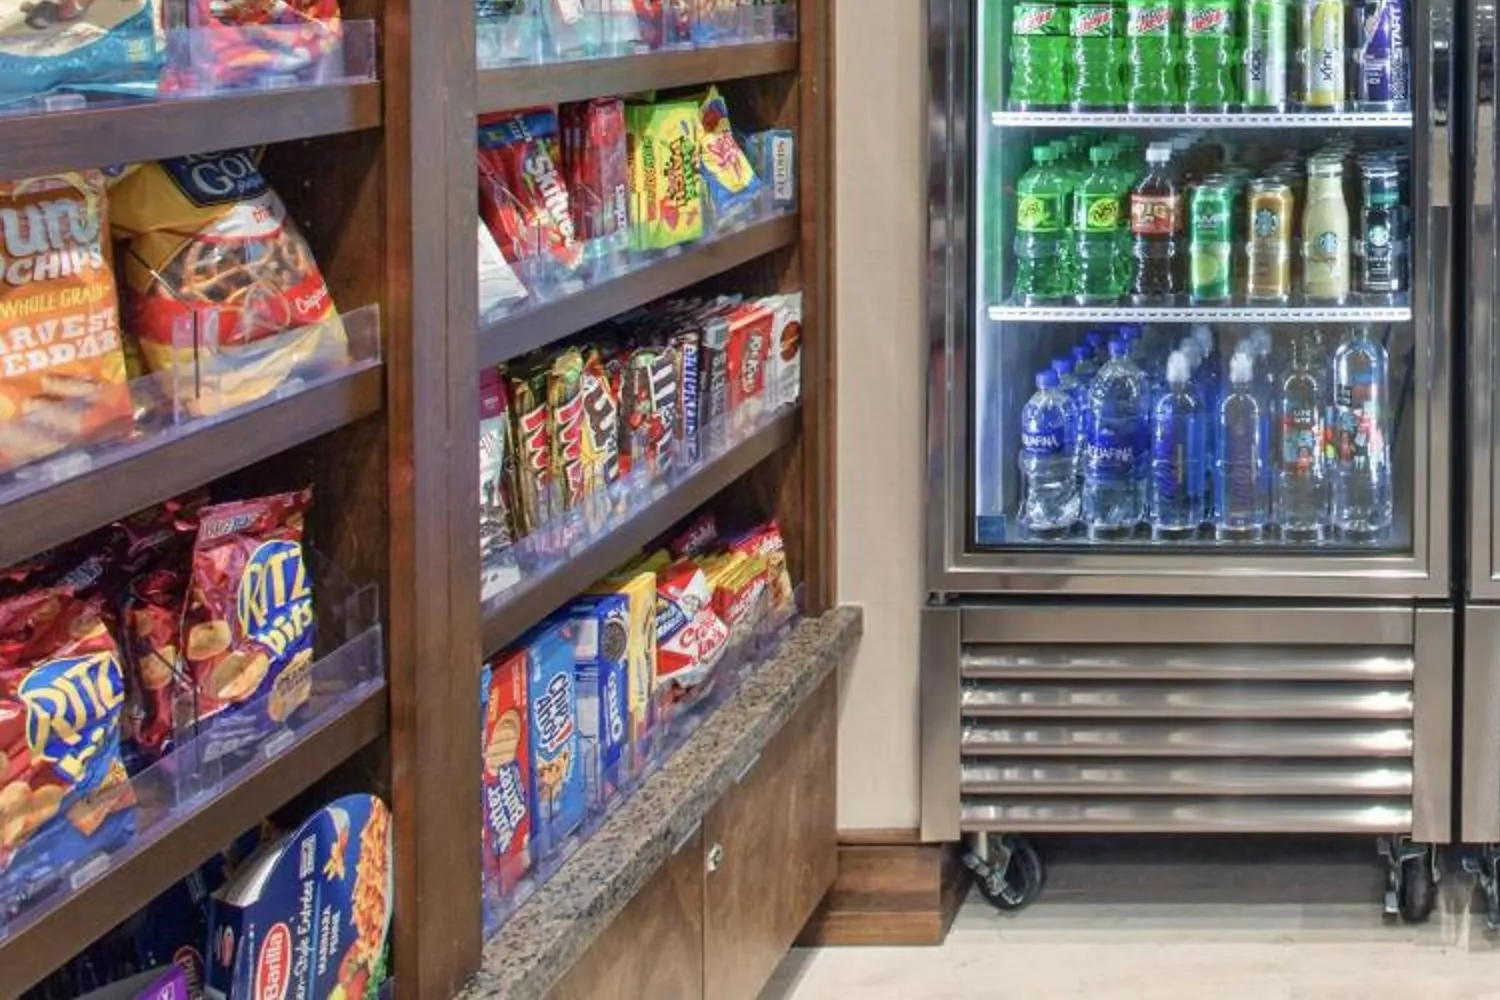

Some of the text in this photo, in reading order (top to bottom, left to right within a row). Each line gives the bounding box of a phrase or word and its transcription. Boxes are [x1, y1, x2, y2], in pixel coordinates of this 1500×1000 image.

[0, 198, 98, 258] un
[7, 243, 103, 286] CHIPS
[0, 306, 118, 355] RVEST
[3, 330, 119, 378] EDDAR
[242, 547, 311, 638] RITZ
[263, 931, 286, 1000] Barilla
